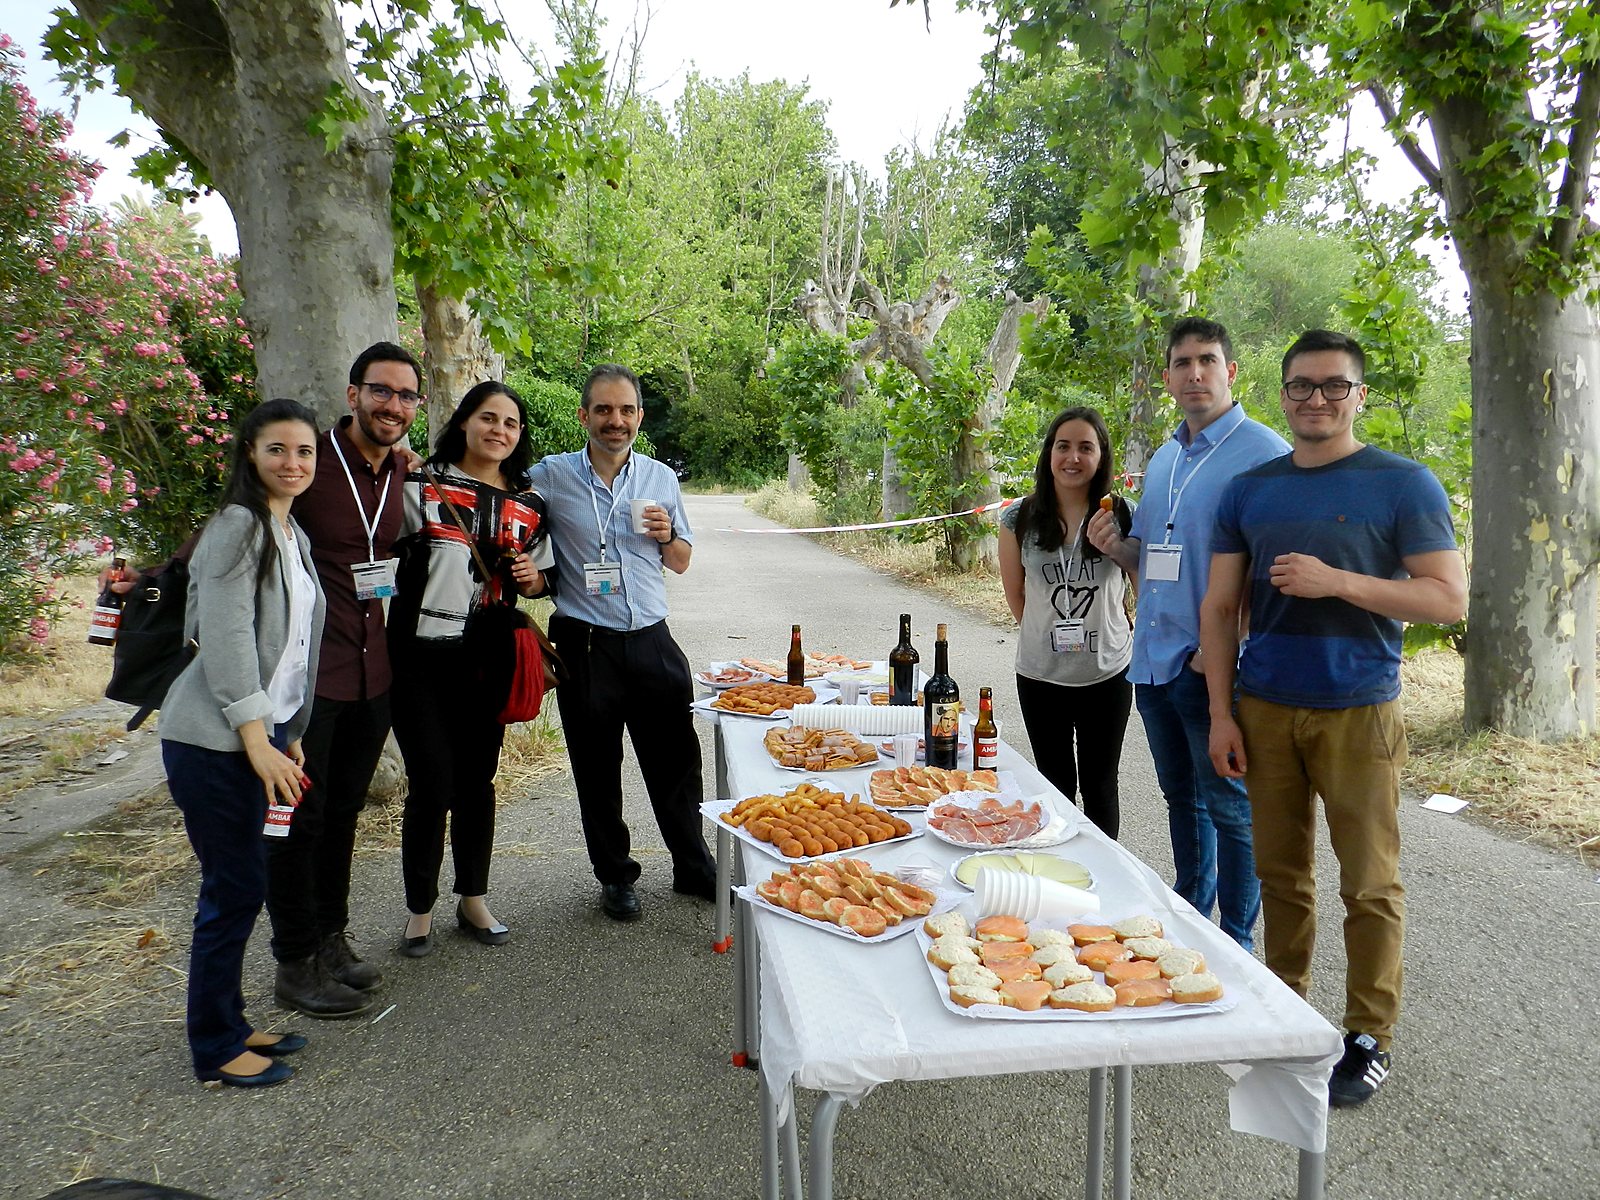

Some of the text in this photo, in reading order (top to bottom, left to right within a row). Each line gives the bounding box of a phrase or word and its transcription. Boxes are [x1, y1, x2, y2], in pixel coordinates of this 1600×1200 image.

[1041, 557, 1103, 585] CHEAP
[1050, 630, 1099, 653] LE
[268, 812, 291, 822] AMBAR
